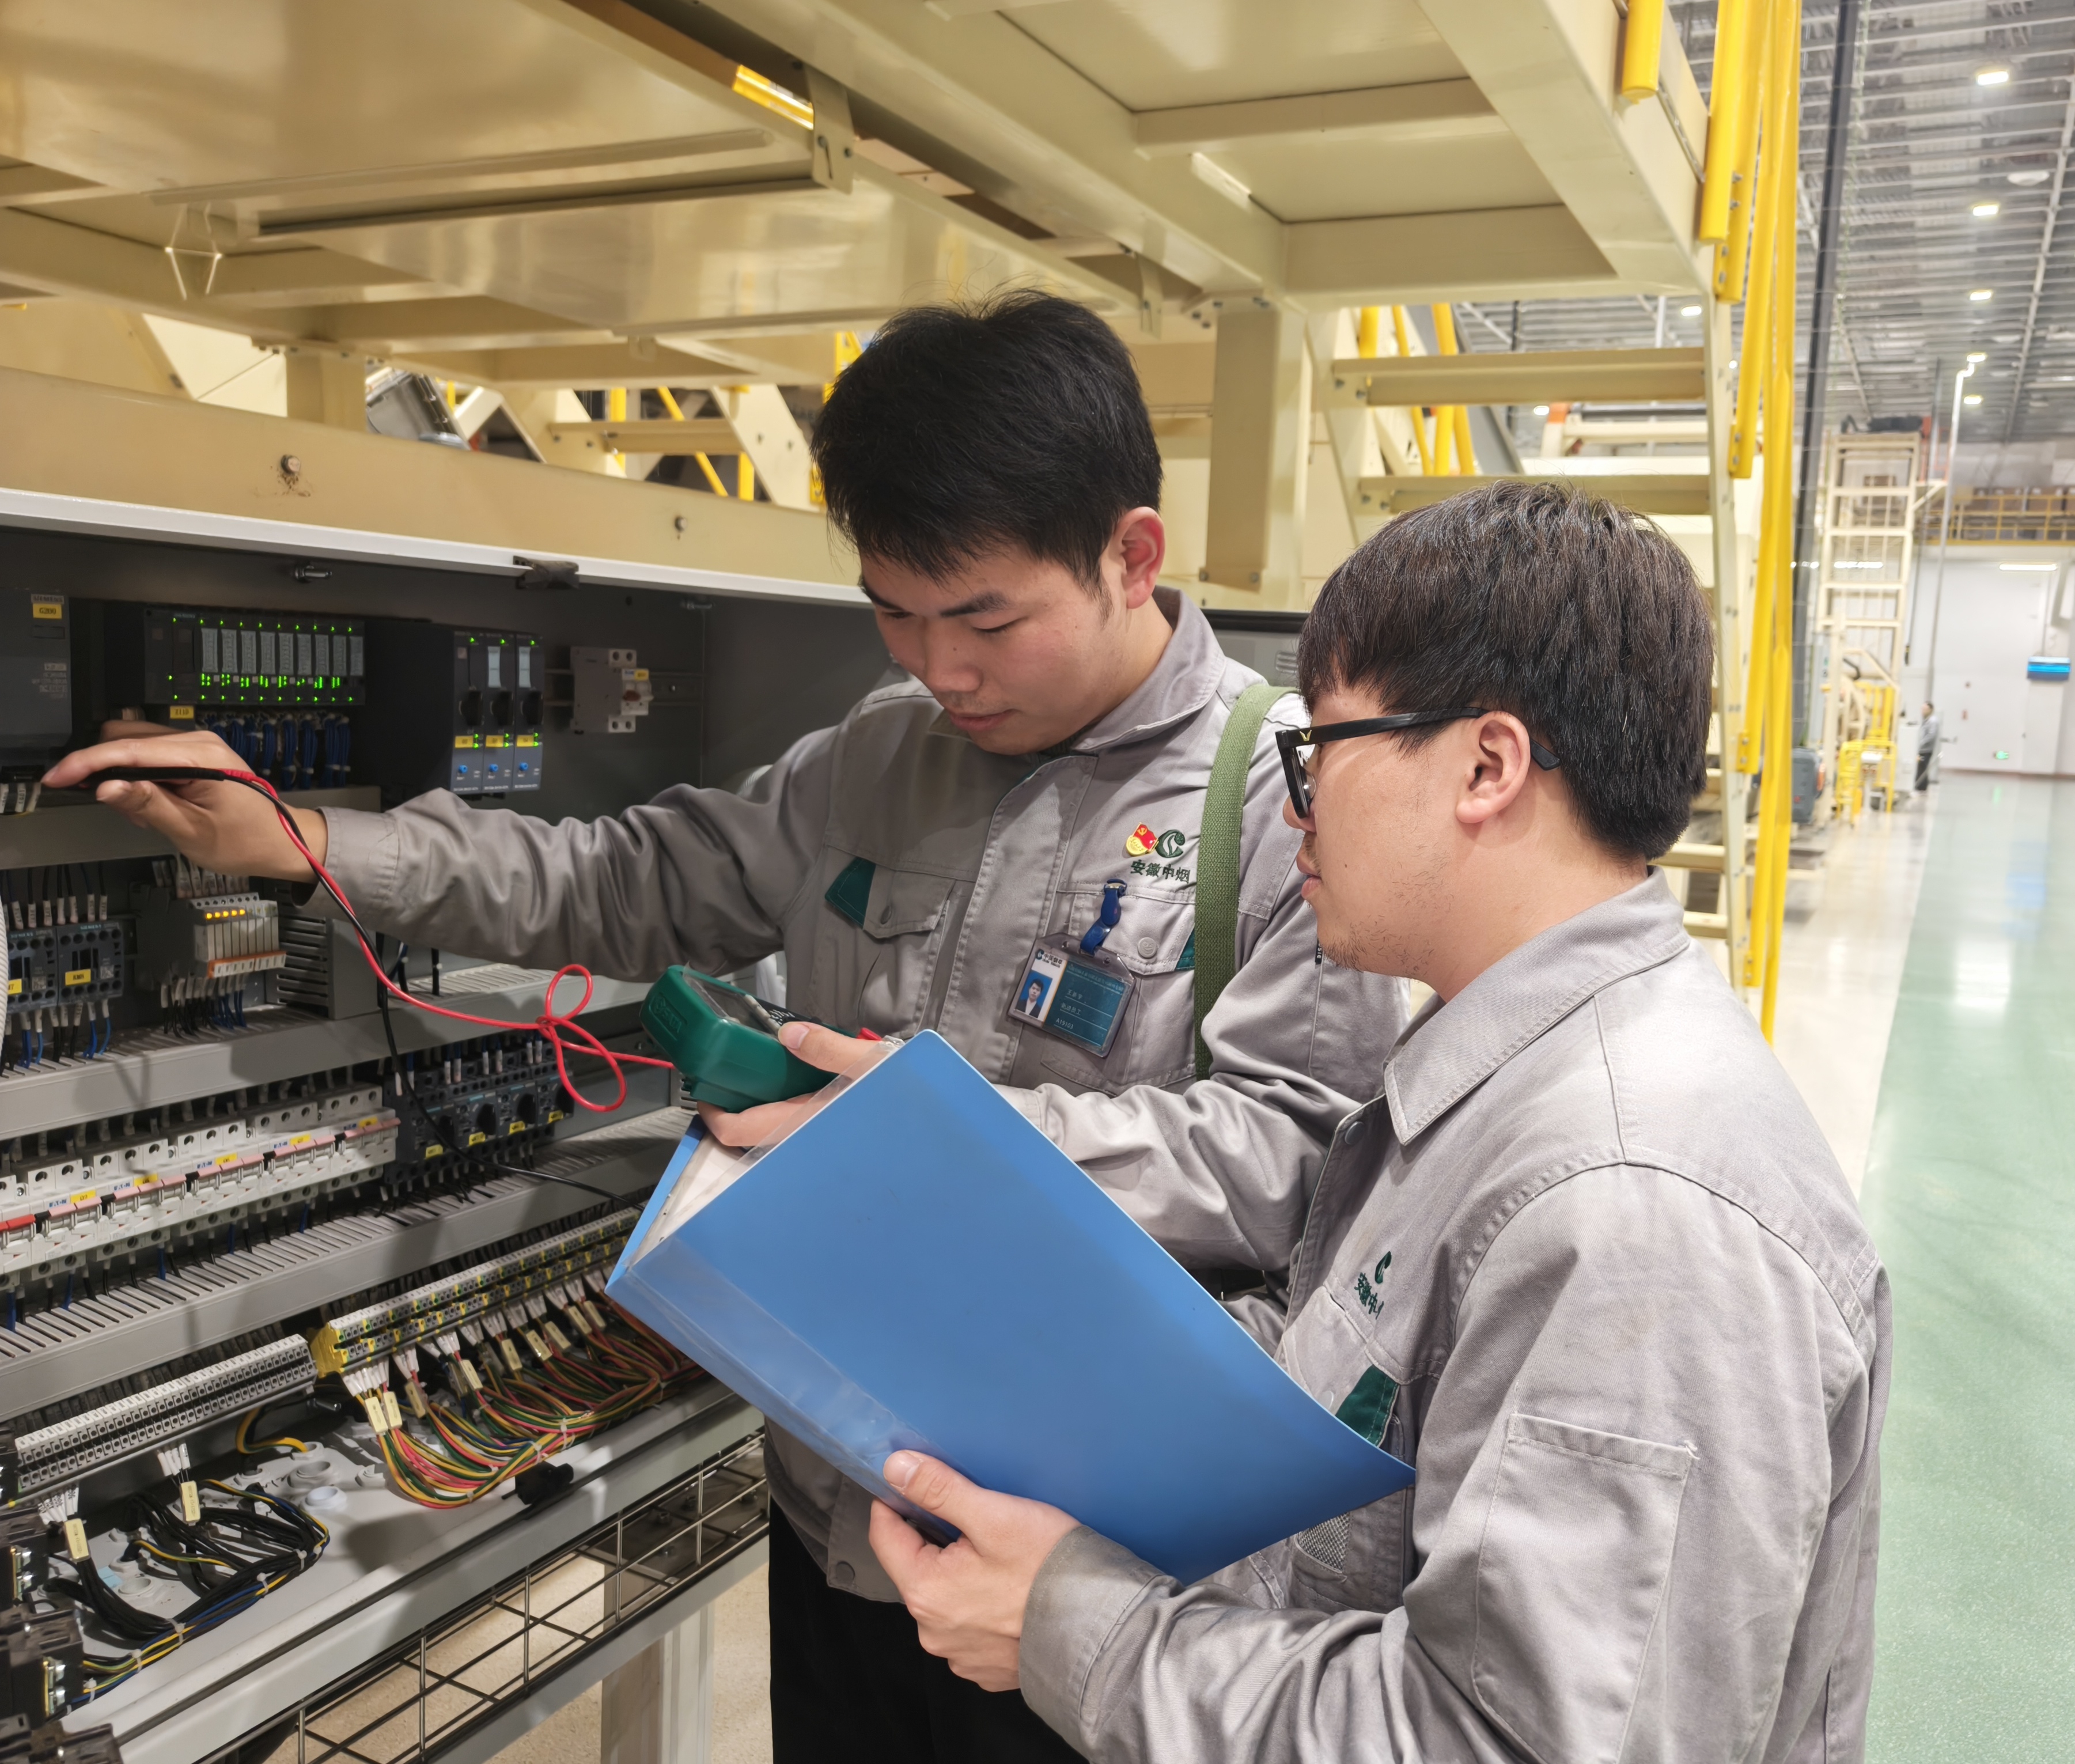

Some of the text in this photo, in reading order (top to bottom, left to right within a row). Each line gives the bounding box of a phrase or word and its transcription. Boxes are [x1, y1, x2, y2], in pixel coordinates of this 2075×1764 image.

[1130, 859, 1191, 884] 安徽中烟
[1055, 1017, 1074, 1029] A19103
